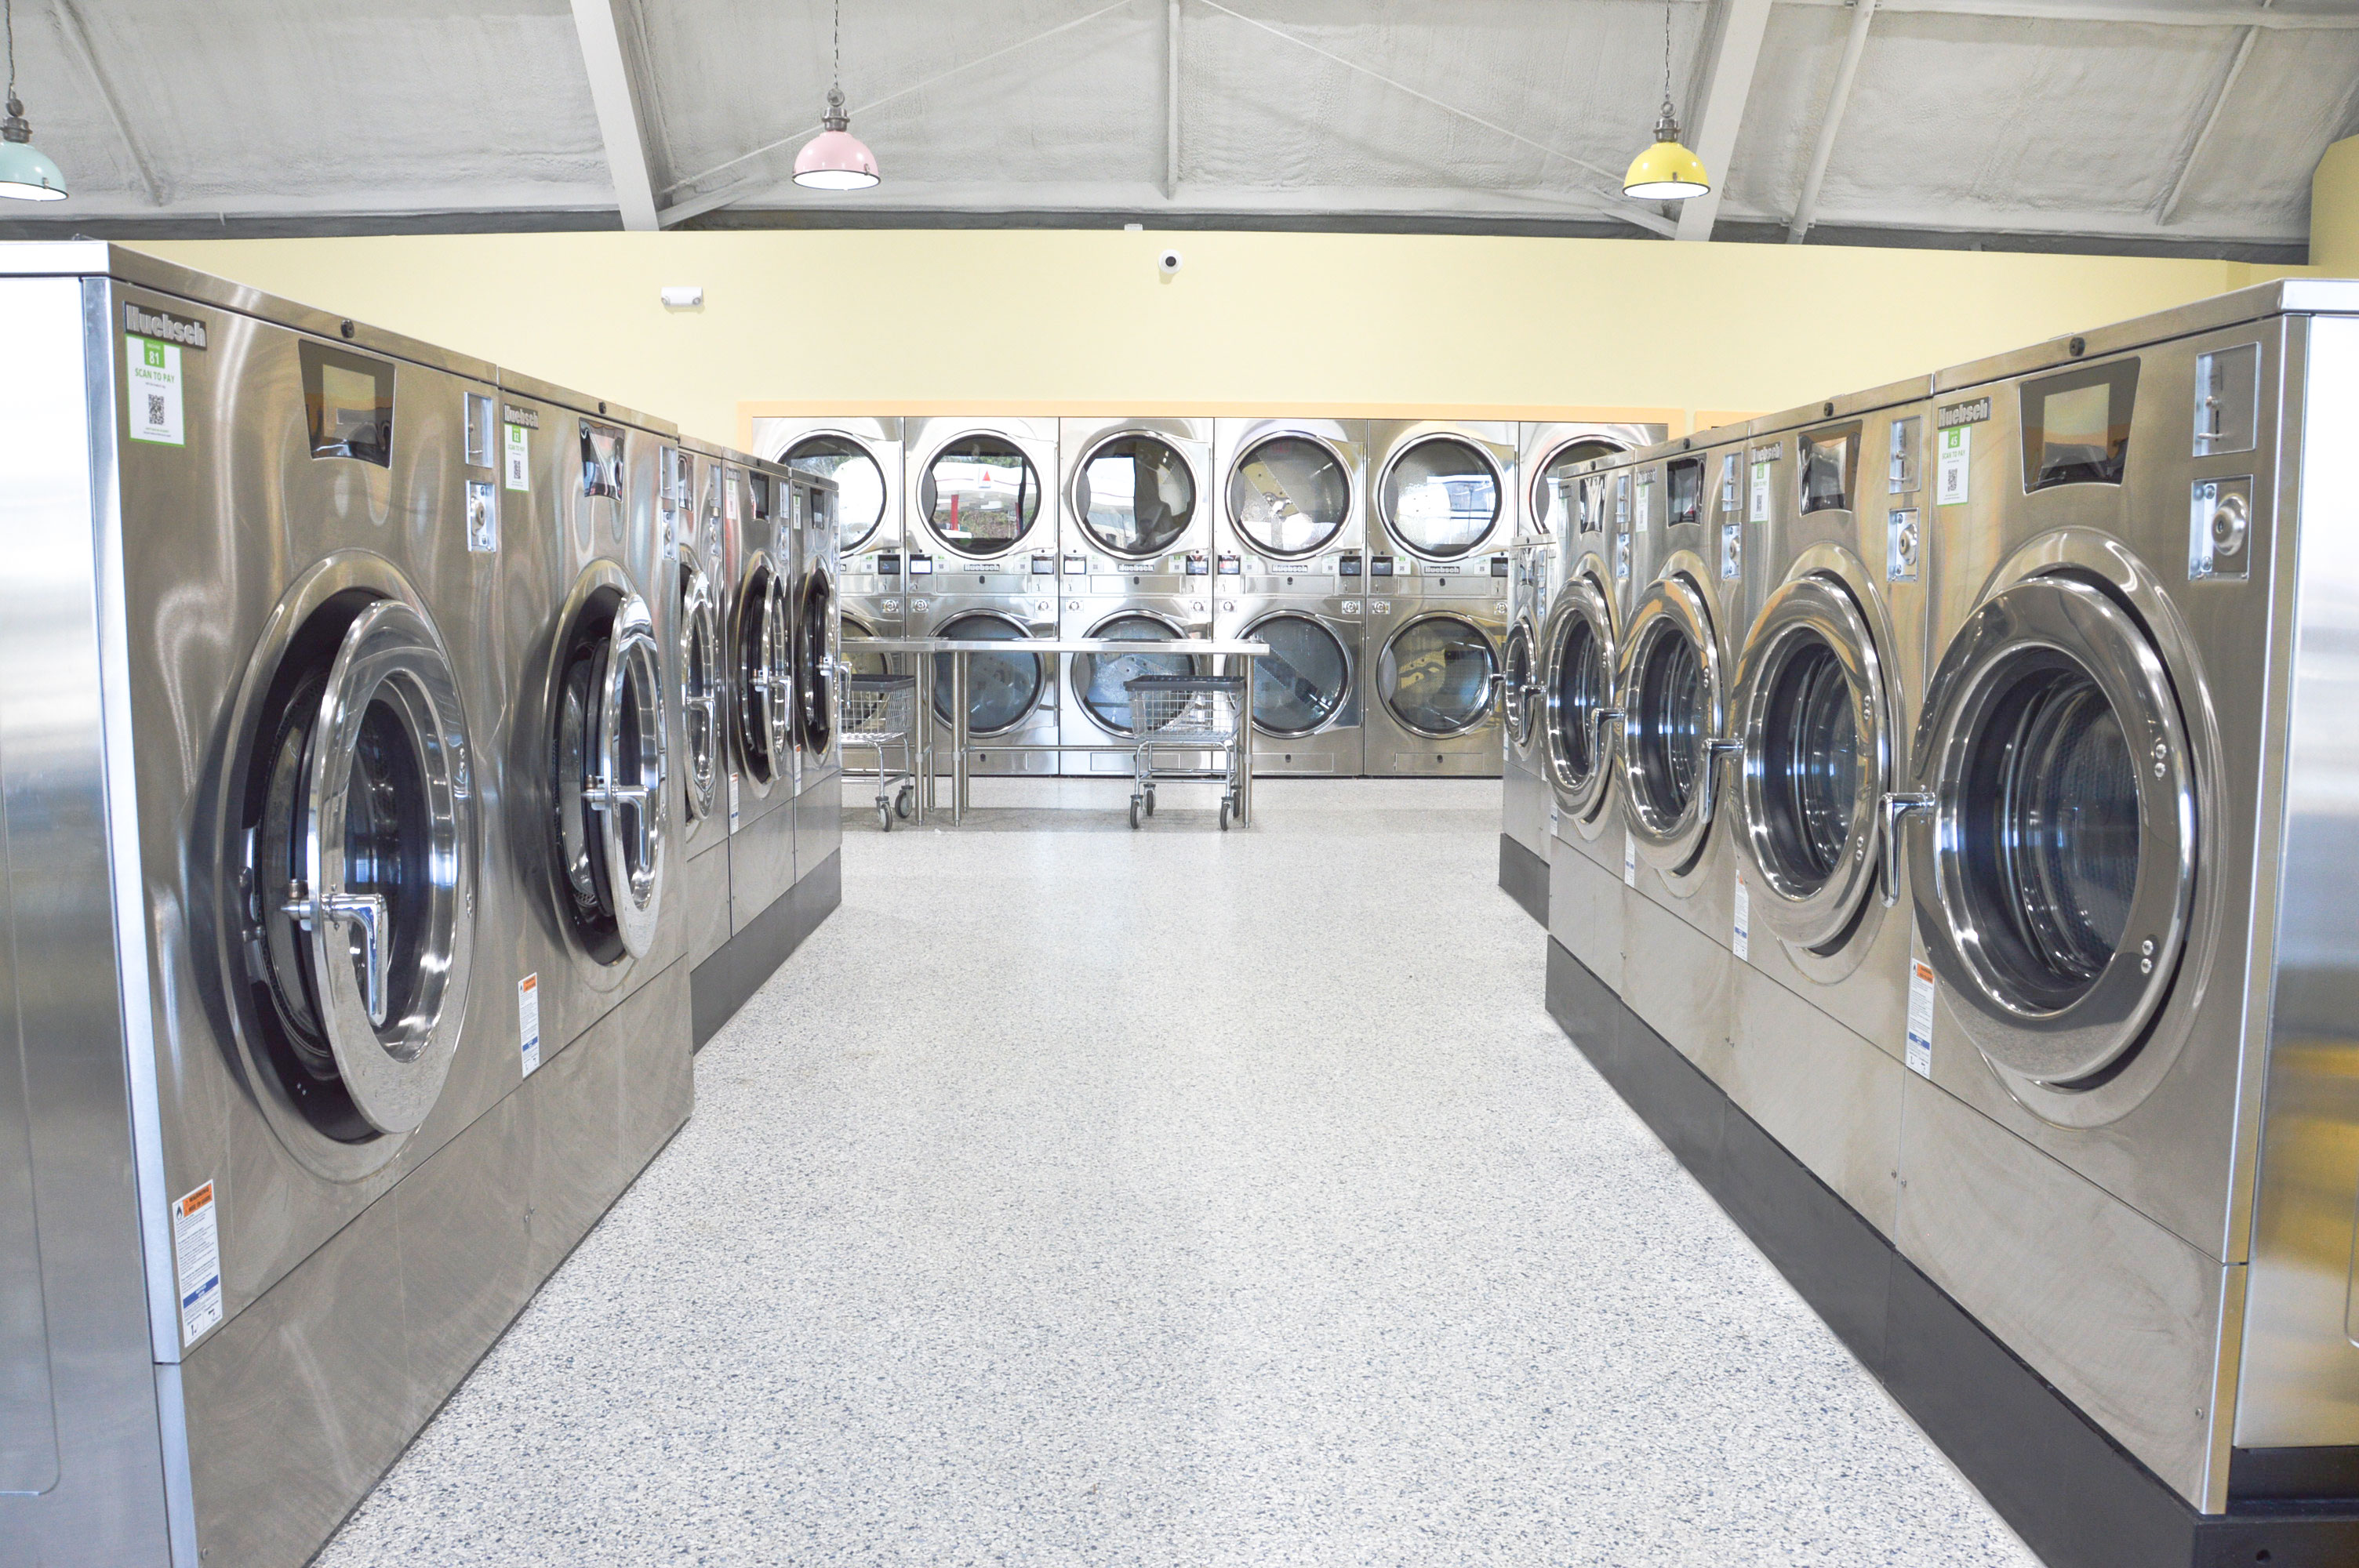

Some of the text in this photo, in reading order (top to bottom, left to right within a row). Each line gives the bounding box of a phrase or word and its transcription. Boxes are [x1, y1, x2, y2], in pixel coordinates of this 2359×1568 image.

[125, 303, 206, 347] Huebsch
[149, 350, 160, 365] 81
[135, 368, 175, 383] SCAN TO PAY
[504, 405, 539, 427] Huebsch
[1938, 399, 1988, 427] Huebsch
[1950, 435, 1958, 447] 45
[1751, 442, 1781, 463] Huebsch
